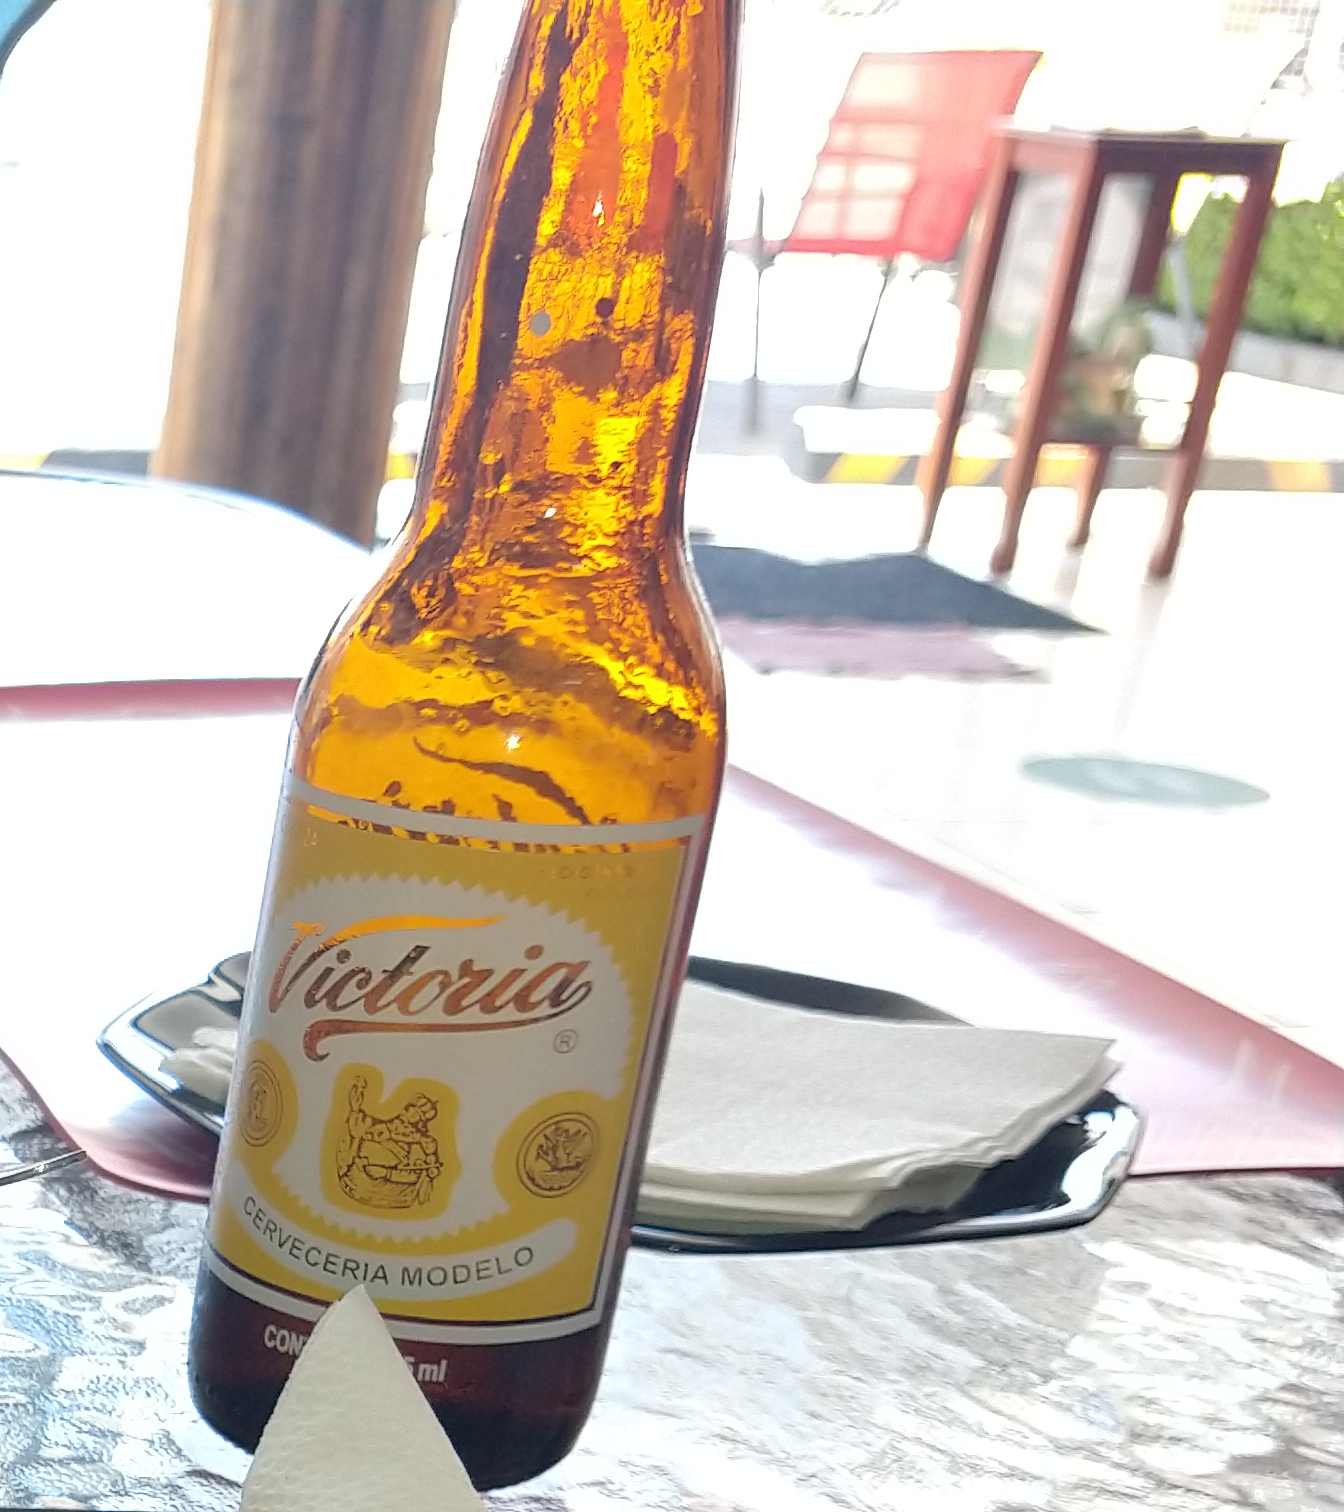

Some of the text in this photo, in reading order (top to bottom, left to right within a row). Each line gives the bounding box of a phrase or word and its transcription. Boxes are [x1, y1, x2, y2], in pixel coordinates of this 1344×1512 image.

[268, 915, 593, 1045] Victoria
[243, 1195, 534, 1288] CERVECERIA MODELO
